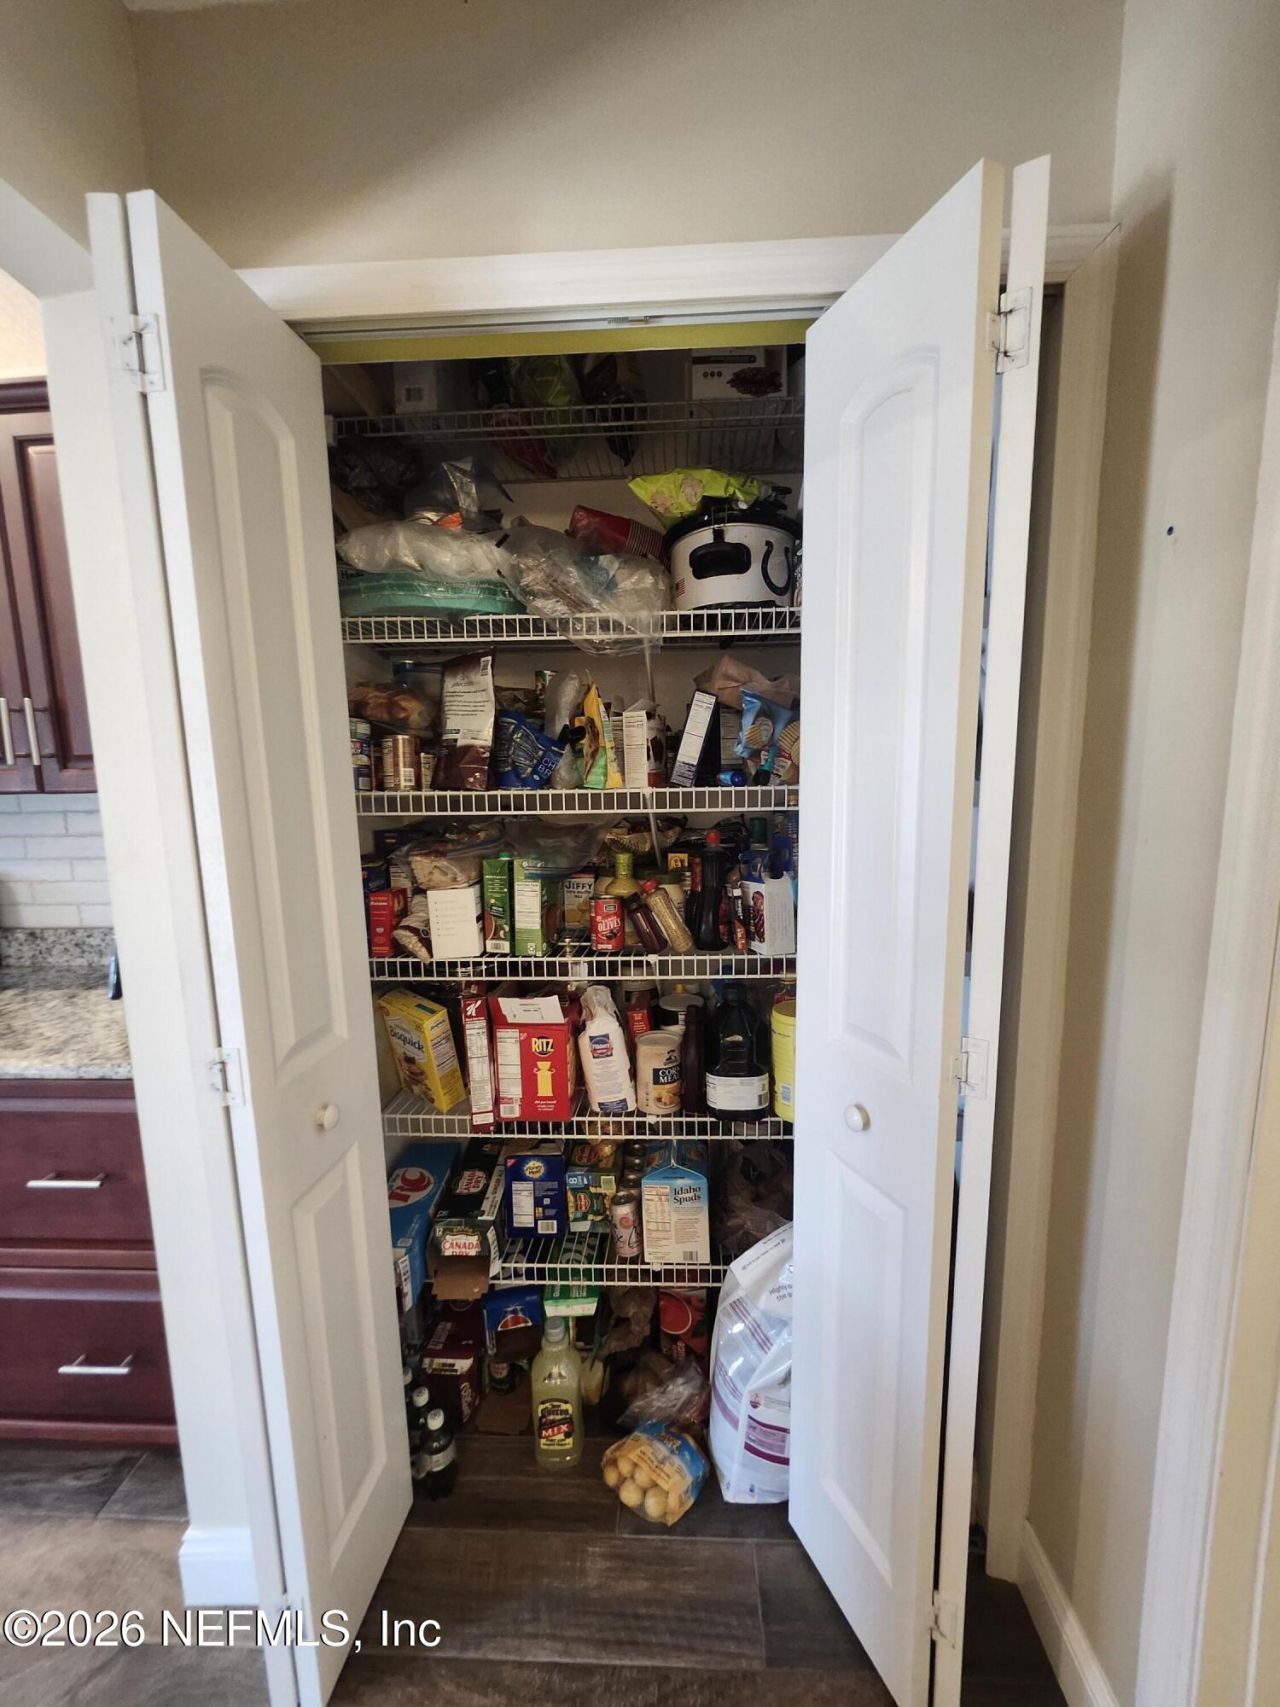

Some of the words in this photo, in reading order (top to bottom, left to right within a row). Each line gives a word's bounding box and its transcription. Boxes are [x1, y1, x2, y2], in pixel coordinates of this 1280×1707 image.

[565, 881, 593, 890] JIFFY
[598, 915, 621, 932] OLIVES
[531, 1037, 555, 1053] RITZ
[673, 1185, 701, 1196] Idaho
[673, 1193, 702, 1206] Spuds
[442, 1240, 481, 1251] CANADA
[542, 1424, 569, 1438] MIX
